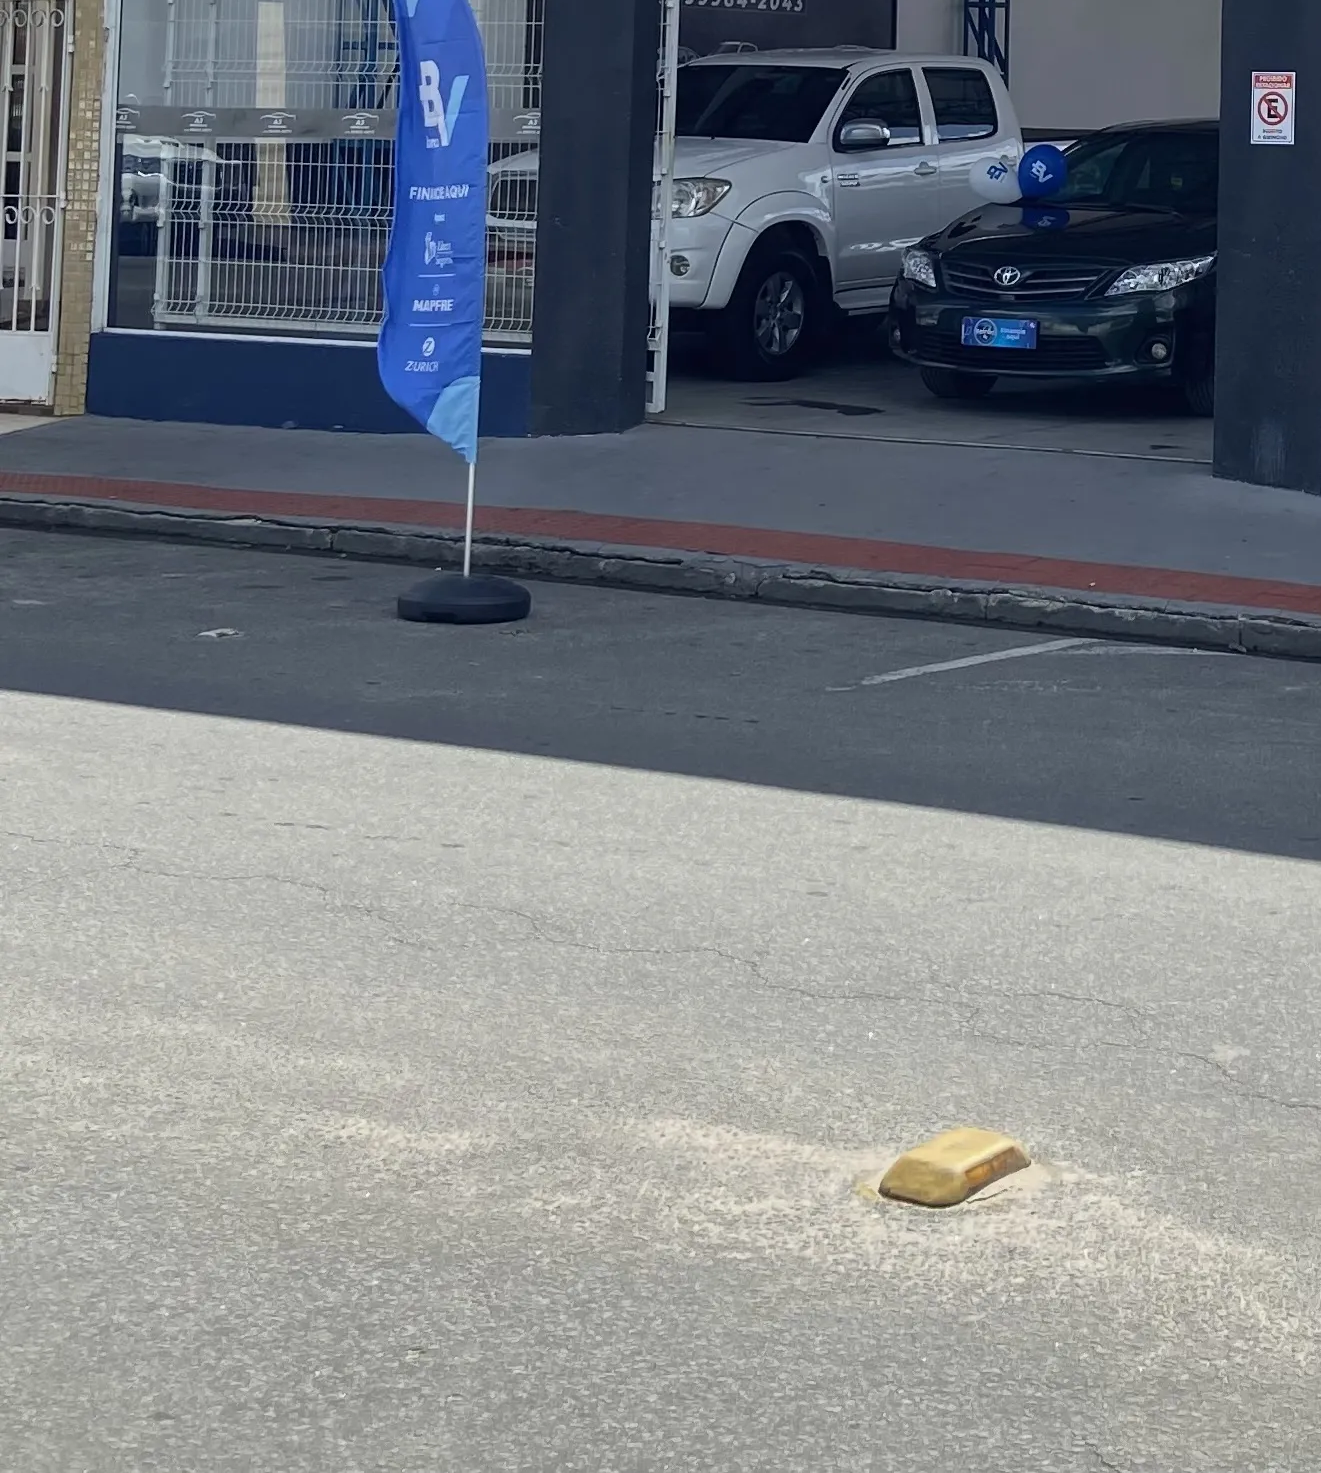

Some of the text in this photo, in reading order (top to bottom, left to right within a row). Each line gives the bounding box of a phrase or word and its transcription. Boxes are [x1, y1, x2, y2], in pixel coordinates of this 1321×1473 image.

[419, 60, 470, 146] BV
[412, 299, 455, 312] MAPFRE
[404, 360, 439, 373] ZURICH
